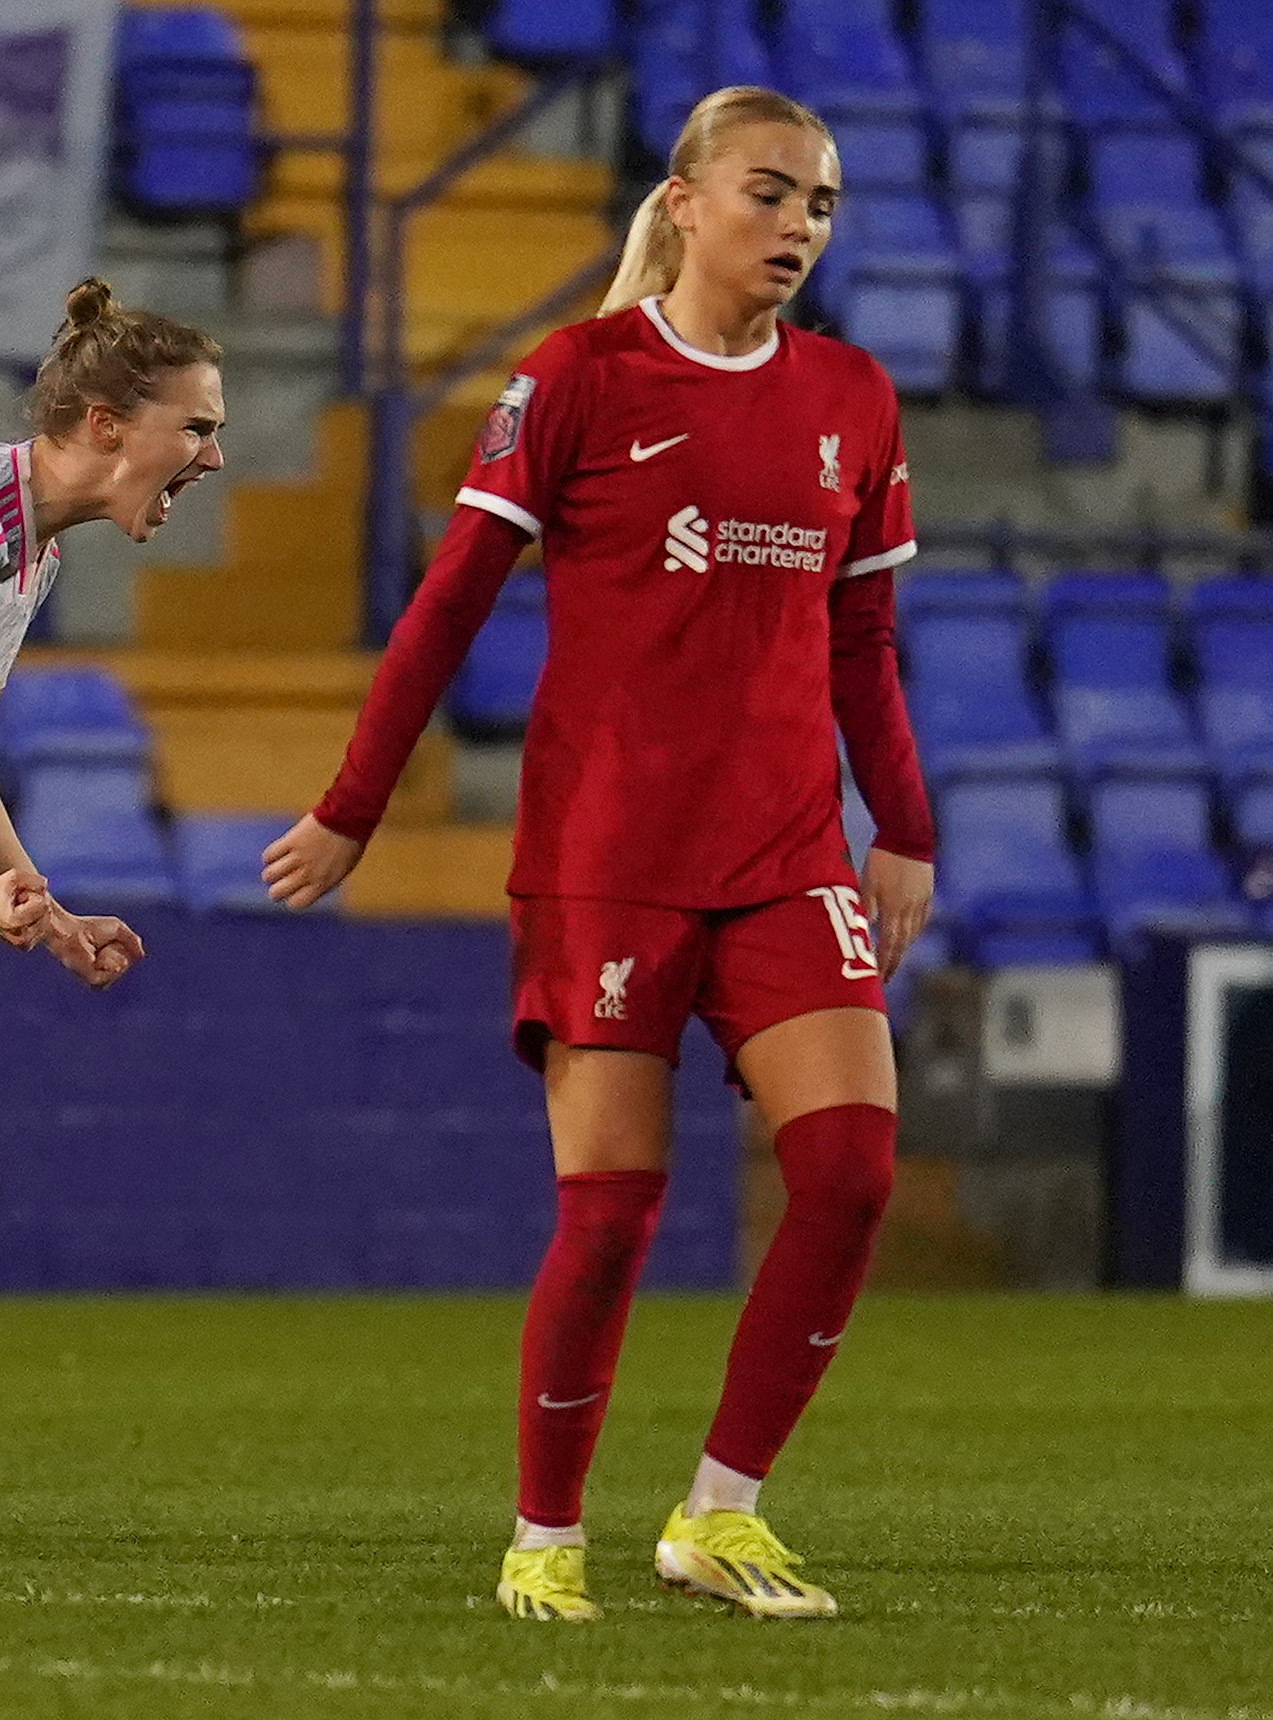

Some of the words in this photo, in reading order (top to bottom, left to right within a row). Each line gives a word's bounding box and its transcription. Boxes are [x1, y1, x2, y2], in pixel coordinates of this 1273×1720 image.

[716, 518, 827, 550] standard
[714, 541, 826, 572] chartered
[806, 885, 879, 980] 15
